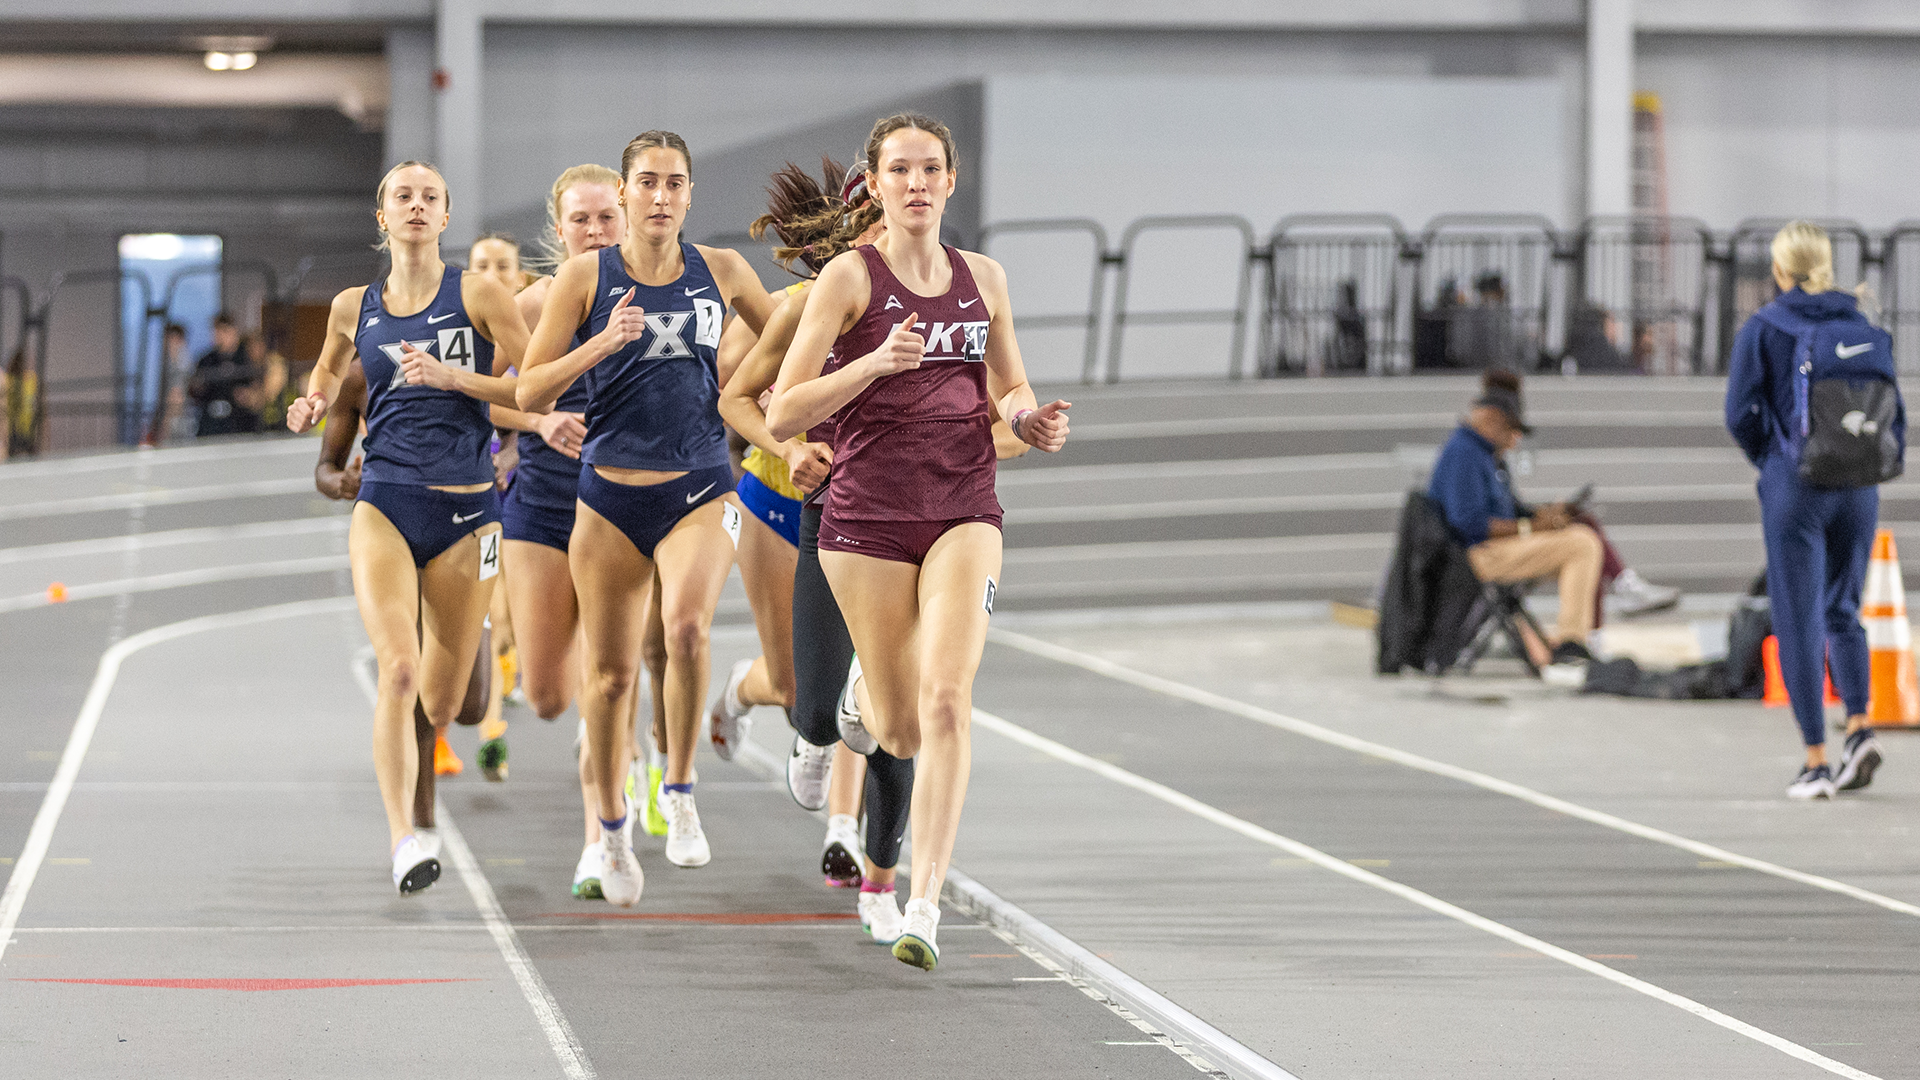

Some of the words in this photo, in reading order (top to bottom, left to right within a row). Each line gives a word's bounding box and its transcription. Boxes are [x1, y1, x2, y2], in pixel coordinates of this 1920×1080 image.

[445, 330, 471, 366] 4
[639, 310, 696, 361] X
[484, 534, 497, 567] 4
